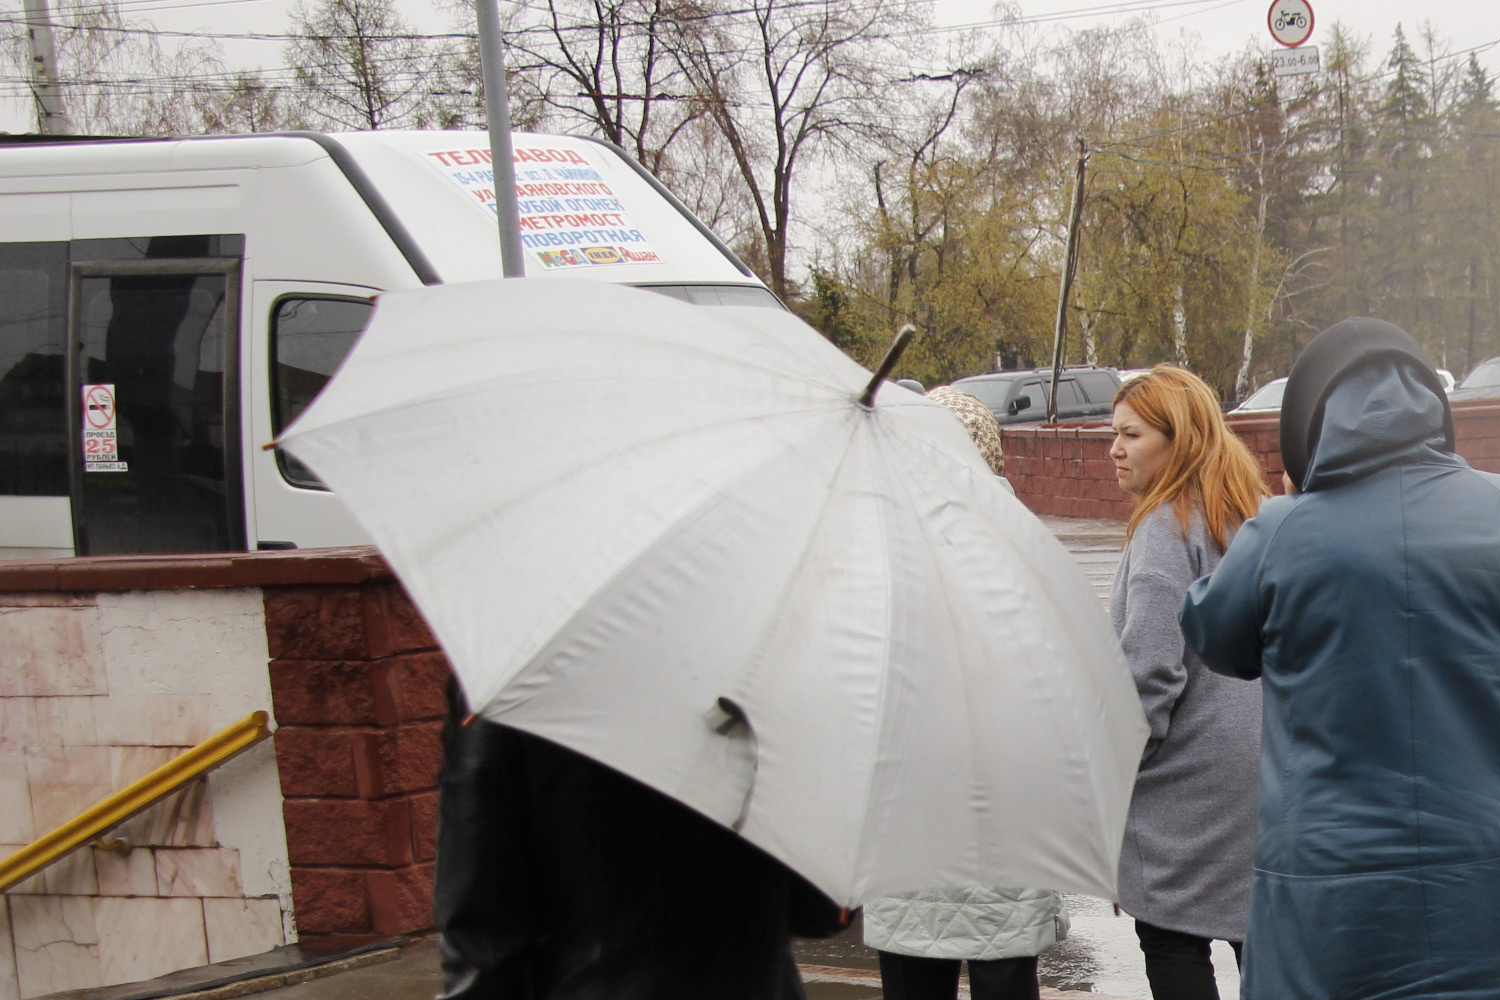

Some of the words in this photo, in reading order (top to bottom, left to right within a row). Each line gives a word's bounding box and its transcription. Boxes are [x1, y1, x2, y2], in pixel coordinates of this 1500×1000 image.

[1273, 55, 1319, 68] 23.00-6.00
[427, 149, 590, 167] ТЕЛЕАВОД
[513, 182, 613, 198] АЯКОВСКОГО
[566, 198, 626, 212] ОГОНЕК
[519, 213, 626, 231] МЕТРОМОСТ
[520, 229, 647, 248] ПОВОРОТНАЯ
[589, 250, 618, 260] IKEA
[617, 246, 662, 262] Ашан
[86, 431, 115, 439] ПРОЕЗД
[86, 438, 116, 454] 25
[87, 453, 116, 461] РУБЛЕЙ
